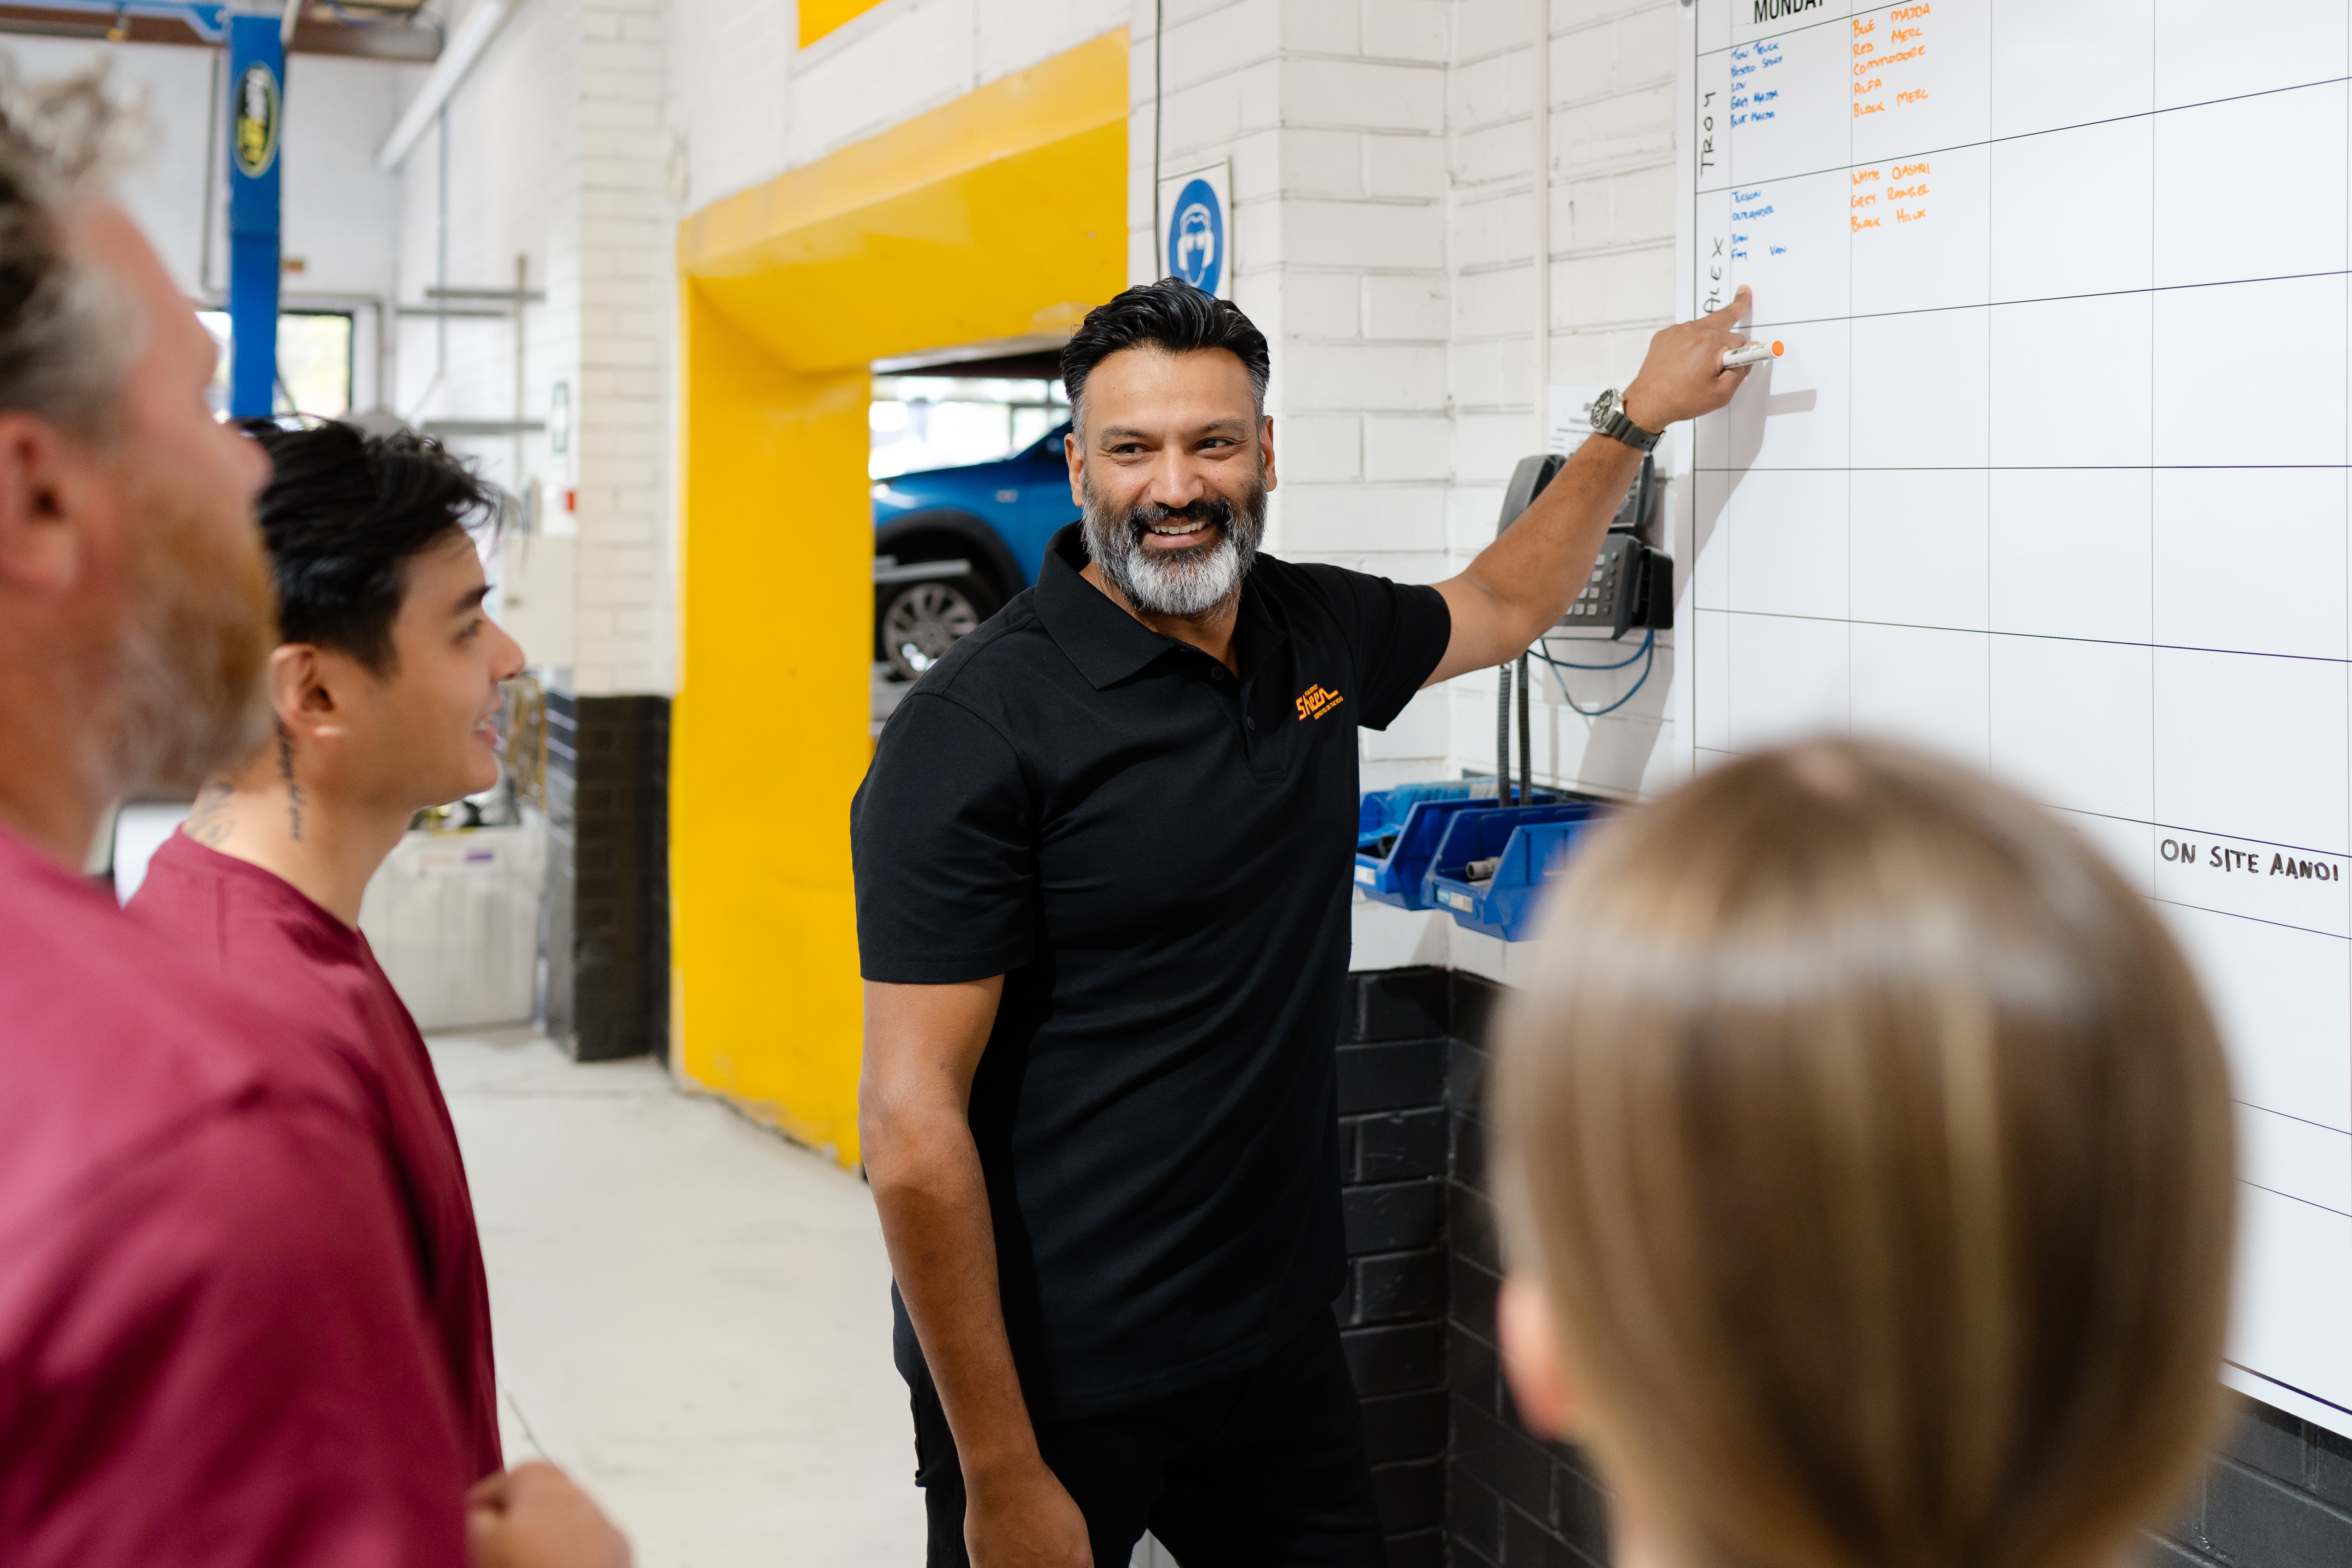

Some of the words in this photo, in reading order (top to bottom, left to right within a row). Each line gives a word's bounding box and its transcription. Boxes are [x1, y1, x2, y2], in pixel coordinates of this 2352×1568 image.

[1852, 19, 1875, 38] BLUE
[1891, 3, 1930, 23] MAZDA
[1853, 43, 1874, 57] RED
[1891, 28, 1923, 44] MERC
[1854, 45, 1926, 76] COMMODORE
[1854, 78, 1882, 95] ALFA
[1897, 89, 1929, 106] MERC
[1851, 194, 1876, 208] GREY
[1703, 236, 1723, 313] ALEX
[2161, 839, 2196, 863] ON
[2209, 846, 2259, 873] SITE
